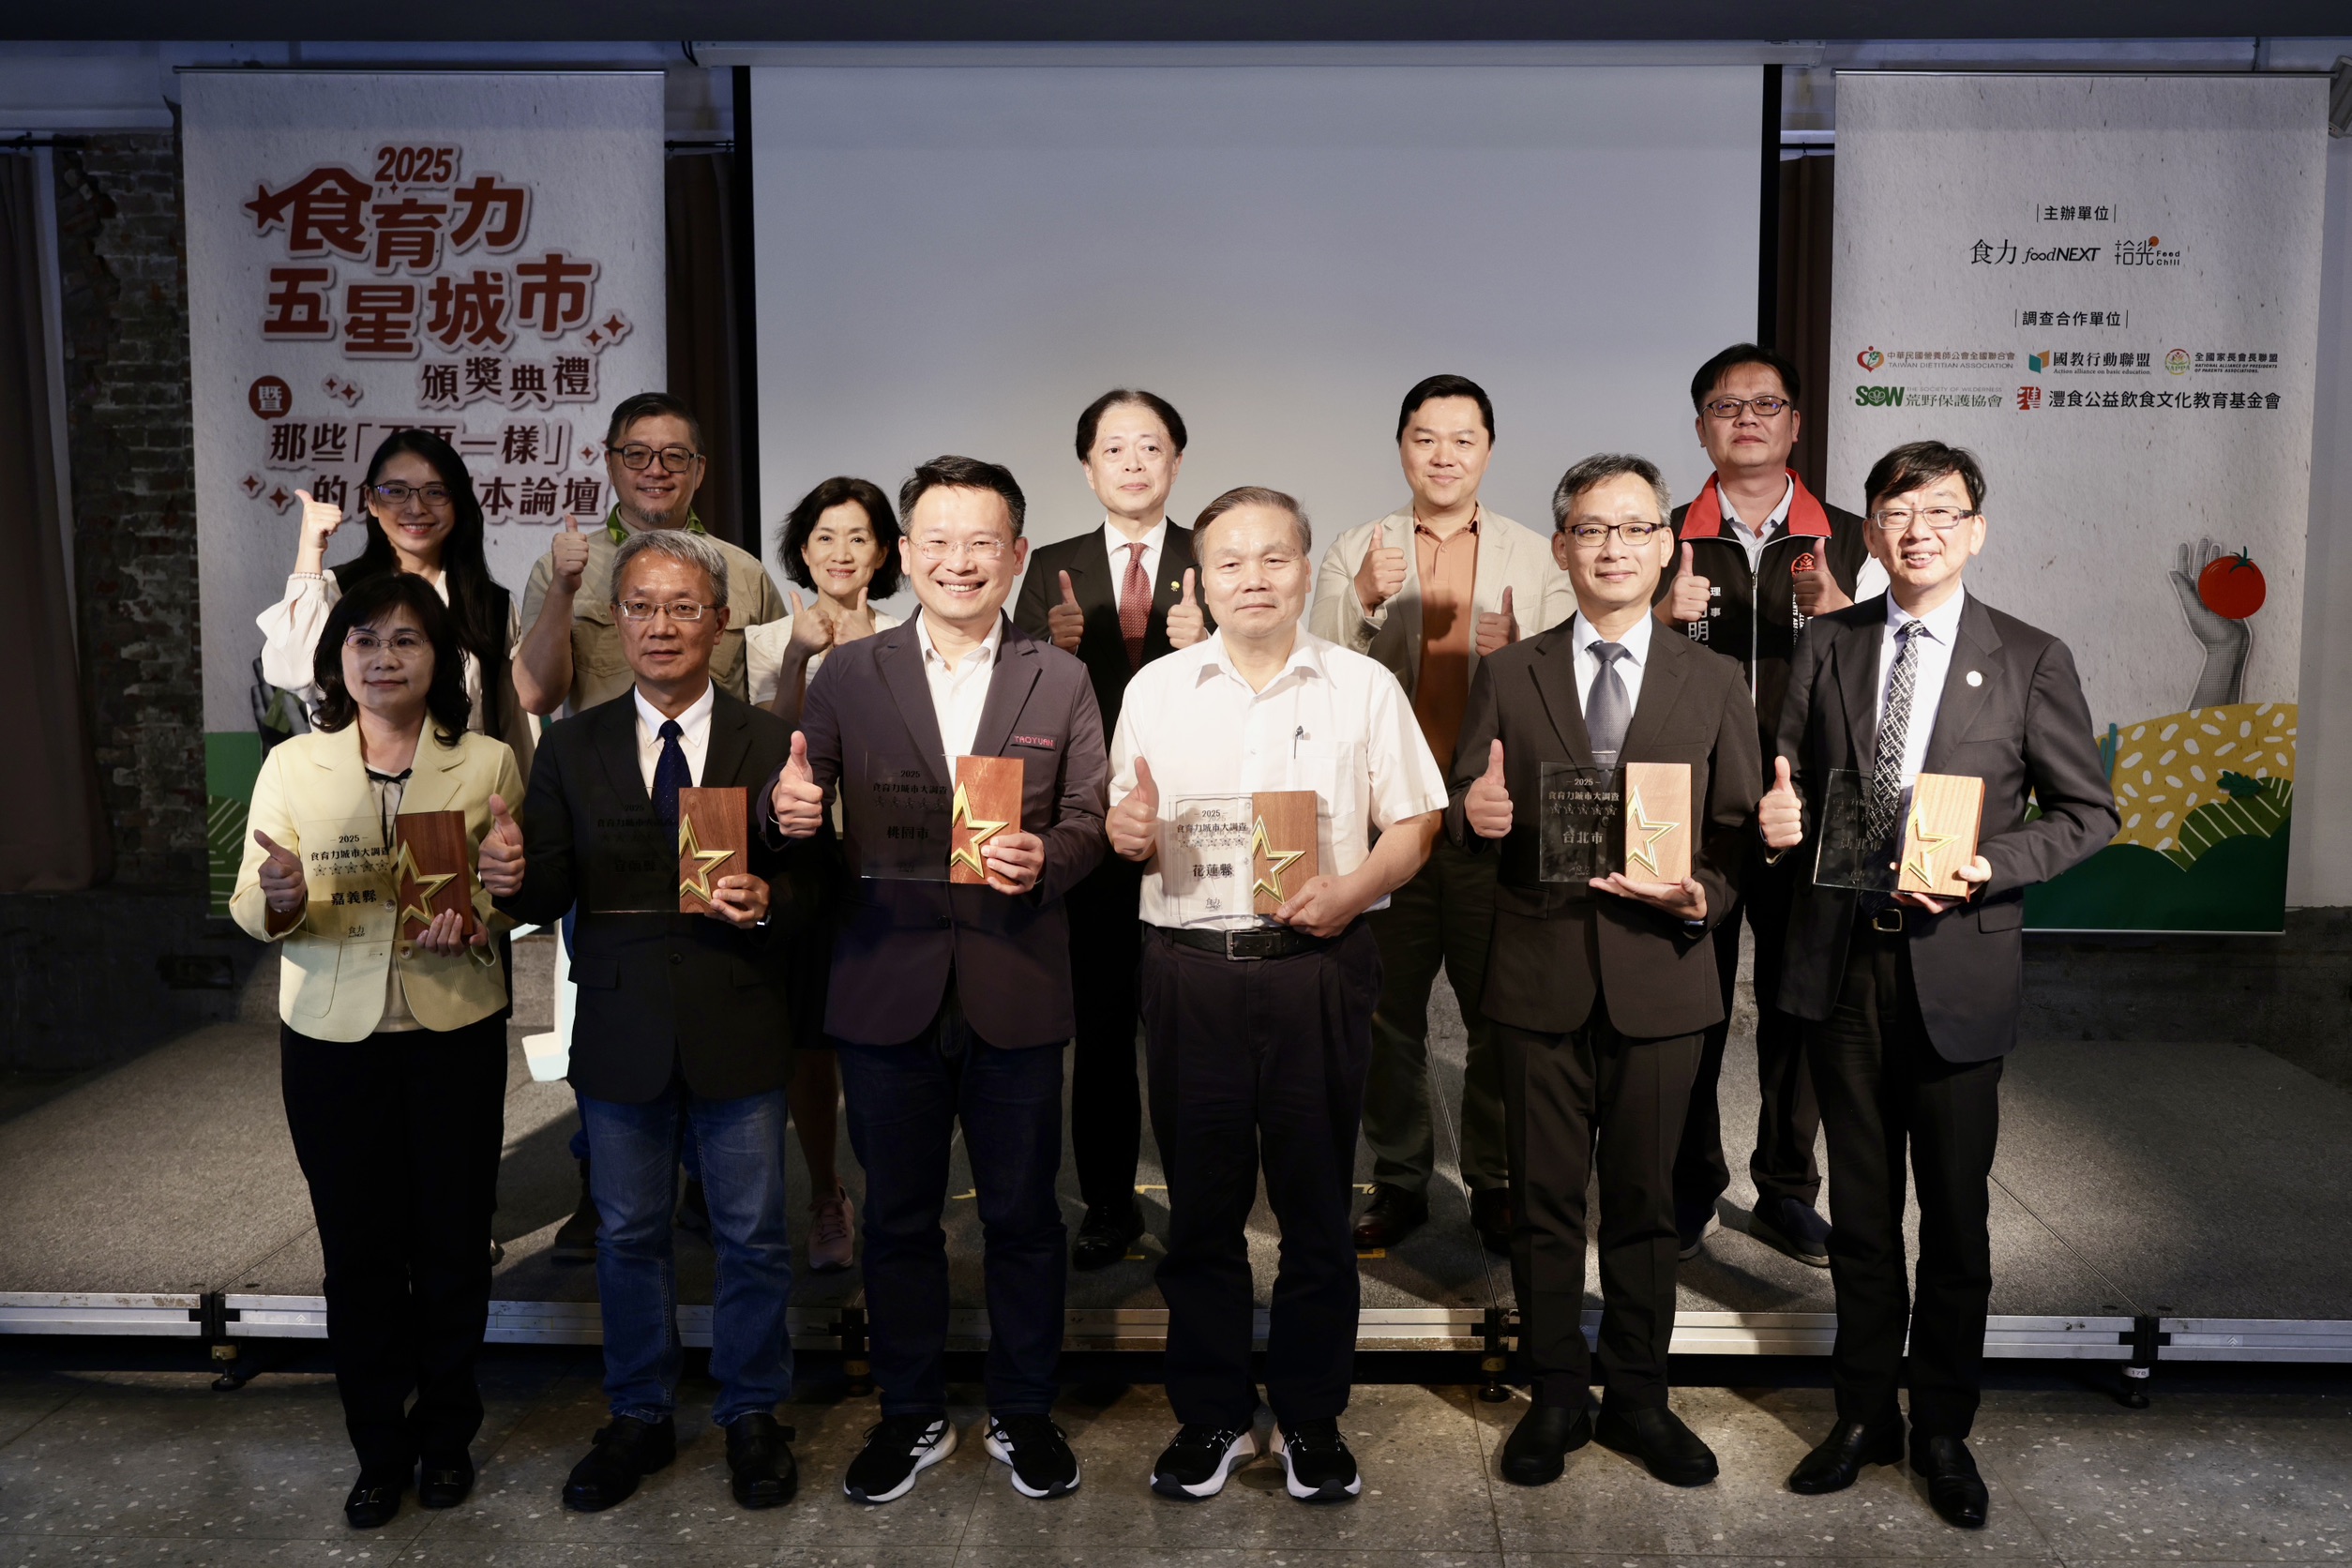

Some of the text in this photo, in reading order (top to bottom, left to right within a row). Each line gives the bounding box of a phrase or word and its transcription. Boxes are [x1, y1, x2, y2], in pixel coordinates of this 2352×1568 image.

[375, 147, 454, 183] 2025
[274, 167, 525, 268] 食育力
[2043, 205, 2109, 221] 主辦單位
[1970, 239, 2101, 264] 食力 foodNEXT
[264, 253, 593, 353] 五星城市
[2023, 311, 2121, 326] 調查合作單位
[1887, 352, 2015, 360] 中華民國營養師公會全國聯合會
[2053, 352, 2150, 367] 國教行動聯盟
[2194, 352, 2278, 363] 全國家長會長聯盟
[422, 355, 591, 404] 頒獎典禮
[257, 384, 284, 412] 暨
[1855, 385, 1905, 407] SOW
[1906, 394, 2003, 408] 荒野保護協會
[2049, 390, 2281, 410] 灃食公益飲食文化教育基金會
[1014, 735, 1054, 746] TAOYUAN
[900, 769, 921, 778] 2025
[873, 782, 947, 795] 食育力城市大調查
[1574, 777, 1593, 786] 2025
[1548, 791, 1620, 802] 食育力城市大調查
[1201, 809, 1220, 818] 2025
[887, 825, 930, 840] 桃園市
[1177, 822, 1247, 834] 食育力城市大調查
[339, 835, 360, 844] 2025
[1562, 830, 1604, 845] 台北市
[310, 846, 390, 861] 食育力城市大調查
[1192, 863, 1234, 878] 花蓮縣
[331, 889, 377, 906] 嘉義縣
[348, 925, 365, 934] 食力
